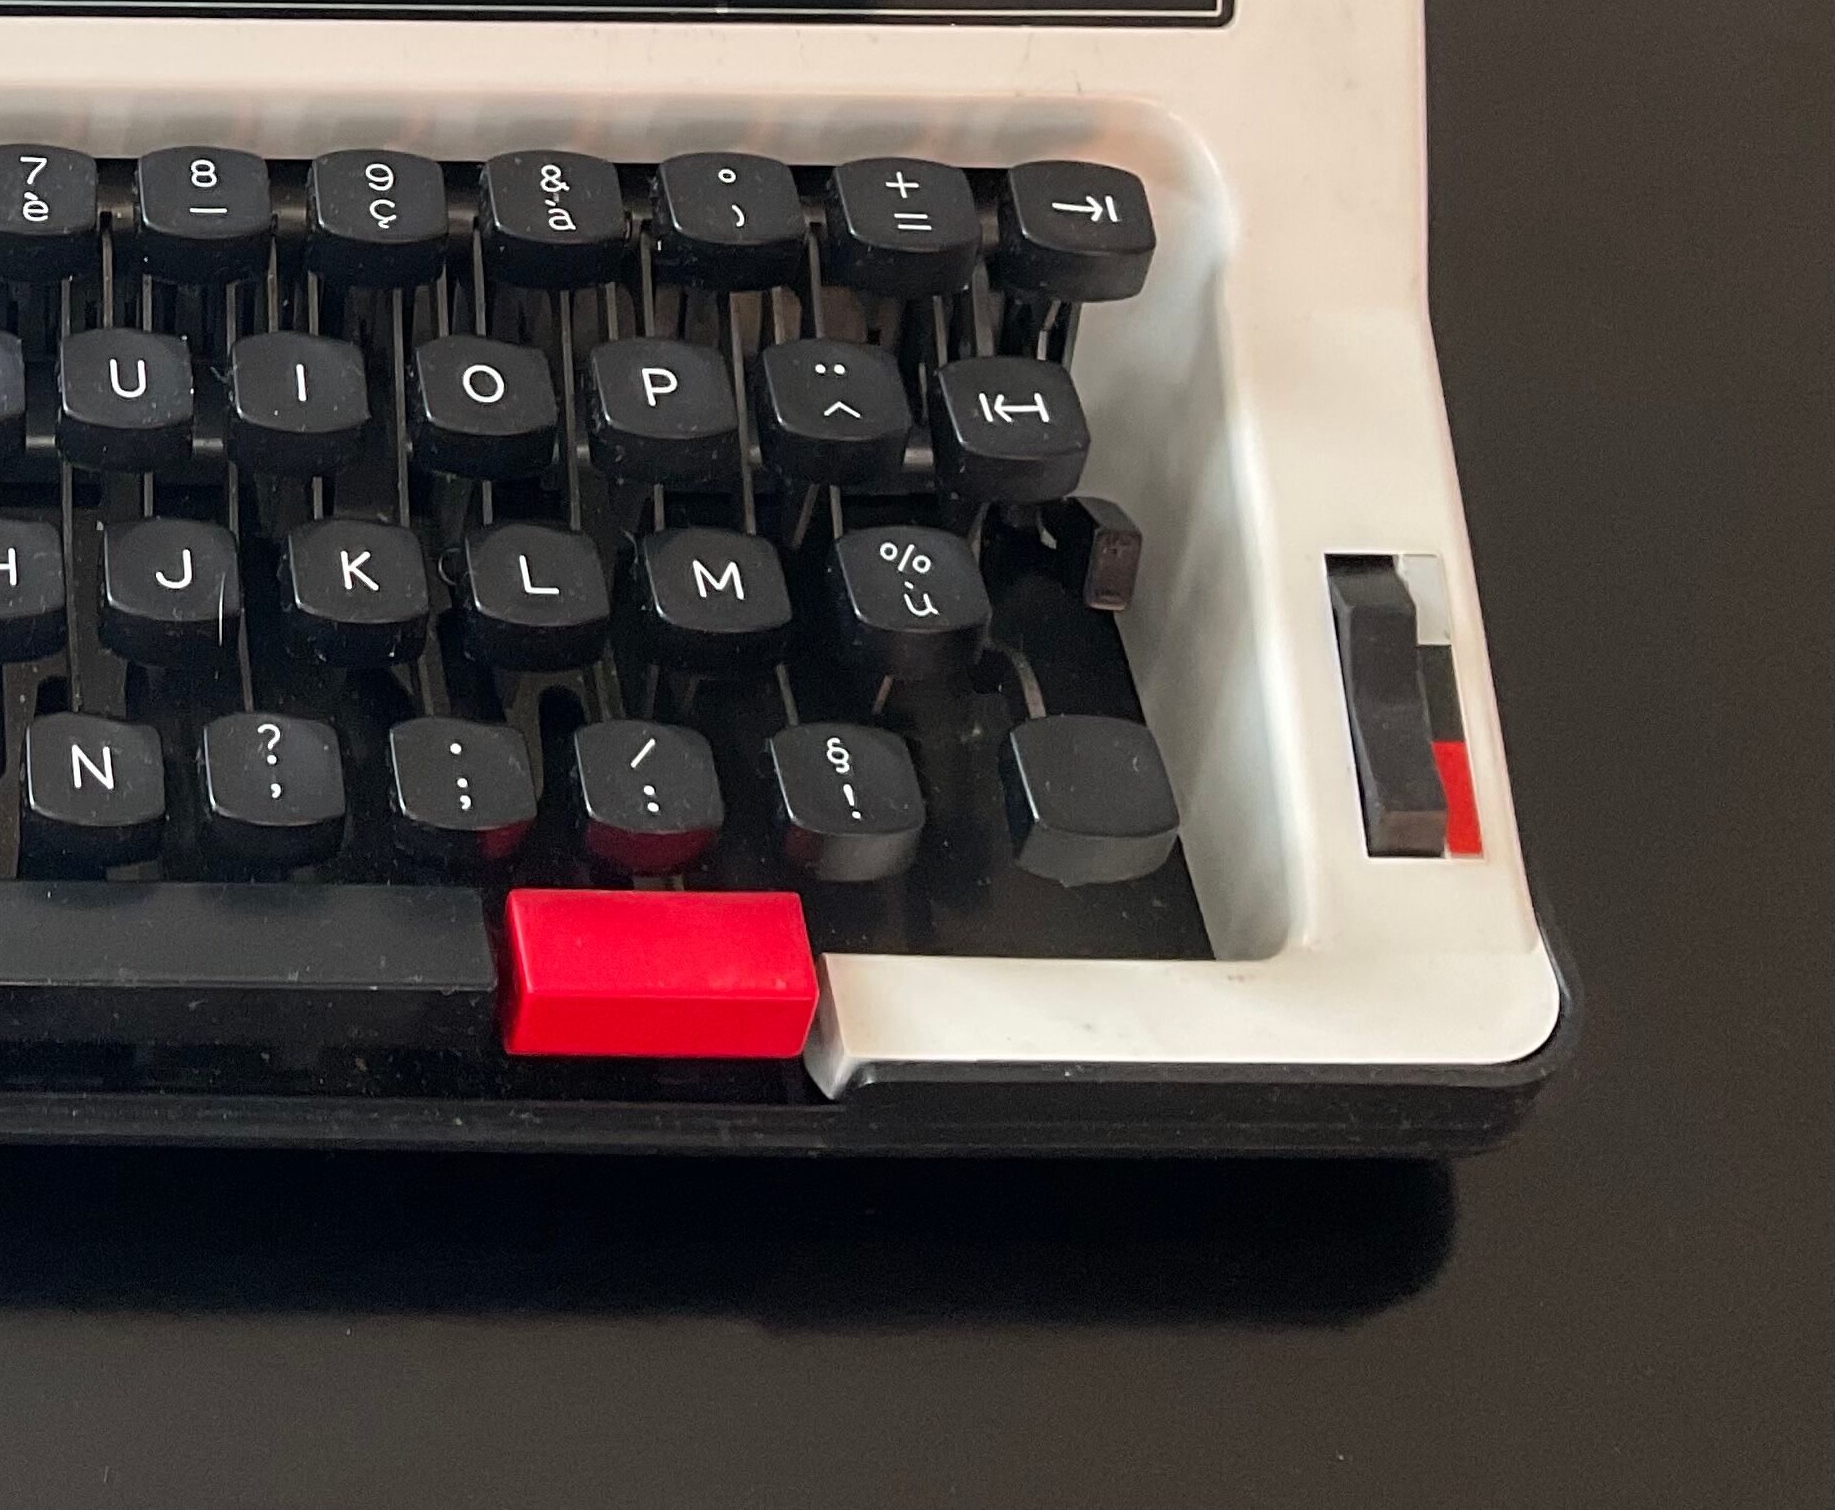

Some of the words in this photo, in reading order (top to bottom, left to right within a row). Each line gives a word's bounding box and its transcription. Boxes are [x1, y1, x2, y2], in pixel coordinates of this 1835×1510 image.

[19, 156, 48, 185] 7
[190, 159, 218, 188] 8
[365, 163, 394, 192] 9
[539, 164, 570, 193] &
[885, 171, 920, 199] +
[22, 191, 49, 222] è
[369, 199, 397, 229] ç
[544, 196, 577, 231] à
[109, 358, 147, 399] U
[295, 363, 307, 402] I
[462, 364, 505, 403] O
[641, 367, 678, 407] P
[155, 549, 193, 589] J
[340, 550, 379, 591] K
[518, 554, 560, 595] L
[879, 542, 932, 574] %
[692, 559, 745, 601] M
[903, 581, 940, 617] ù
[257, 723, 281, 765] ?
[71, 743, 115, 790] N
[842, 783, 862, 820] !
